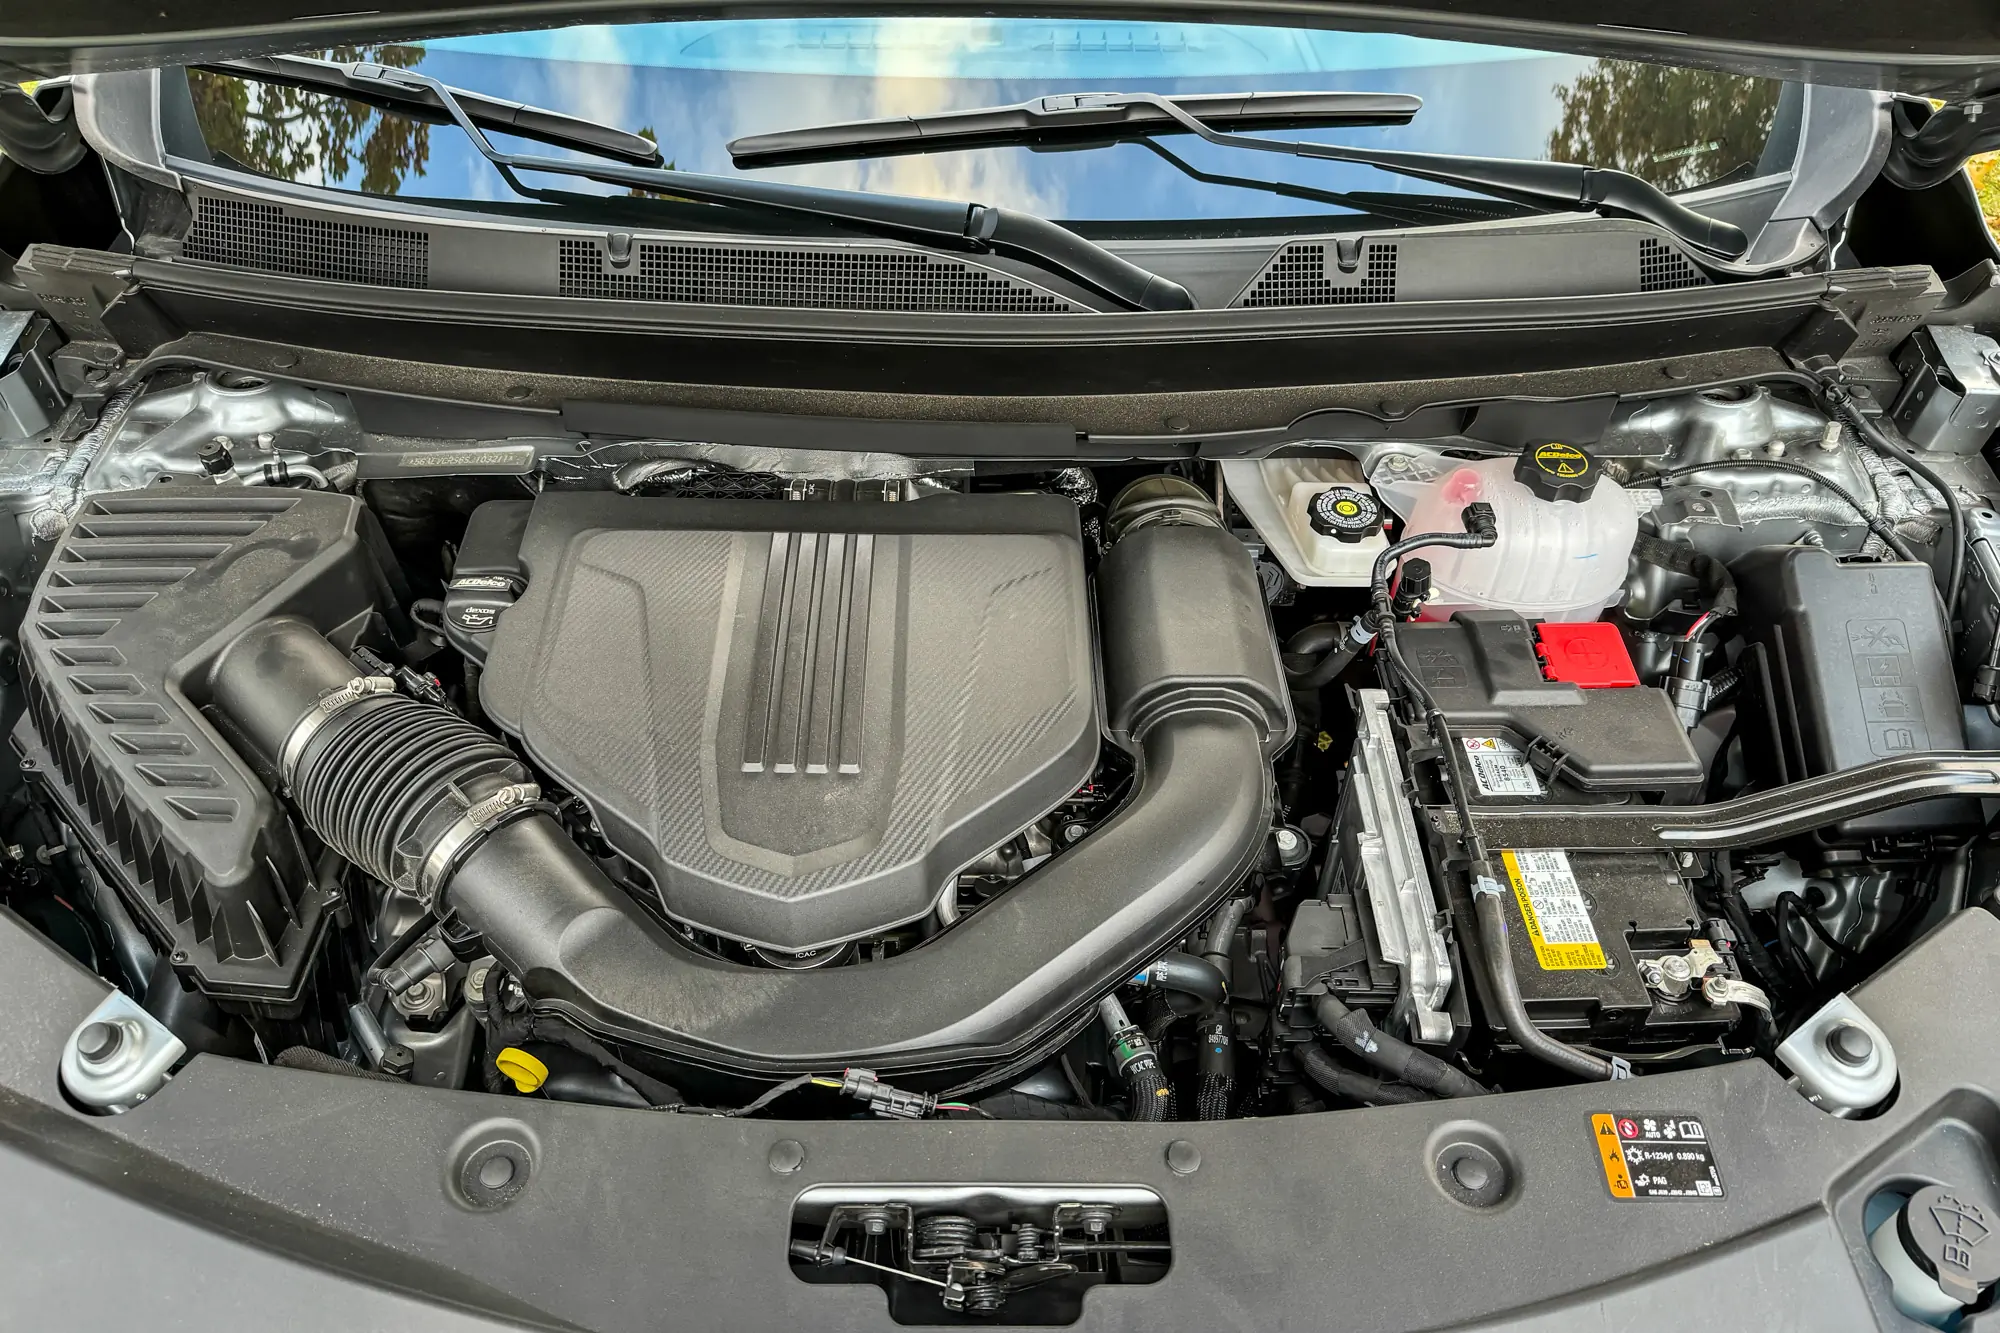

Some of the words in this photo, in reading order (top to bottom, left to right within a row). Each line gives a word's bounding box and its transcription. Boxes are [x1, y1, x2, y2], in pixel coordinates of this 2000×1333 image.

[1538, 451, 1582, 459] ACDelco
[453, 579, 505, 587] ACDelco
[1474, 755, 1490, 790] ACDelco
[1514, 878, 1538, 930] DANGER/POISON
[1696, 1153, 1705, 1162] kg
[1652, 1176, 1668, 1185] PAG
